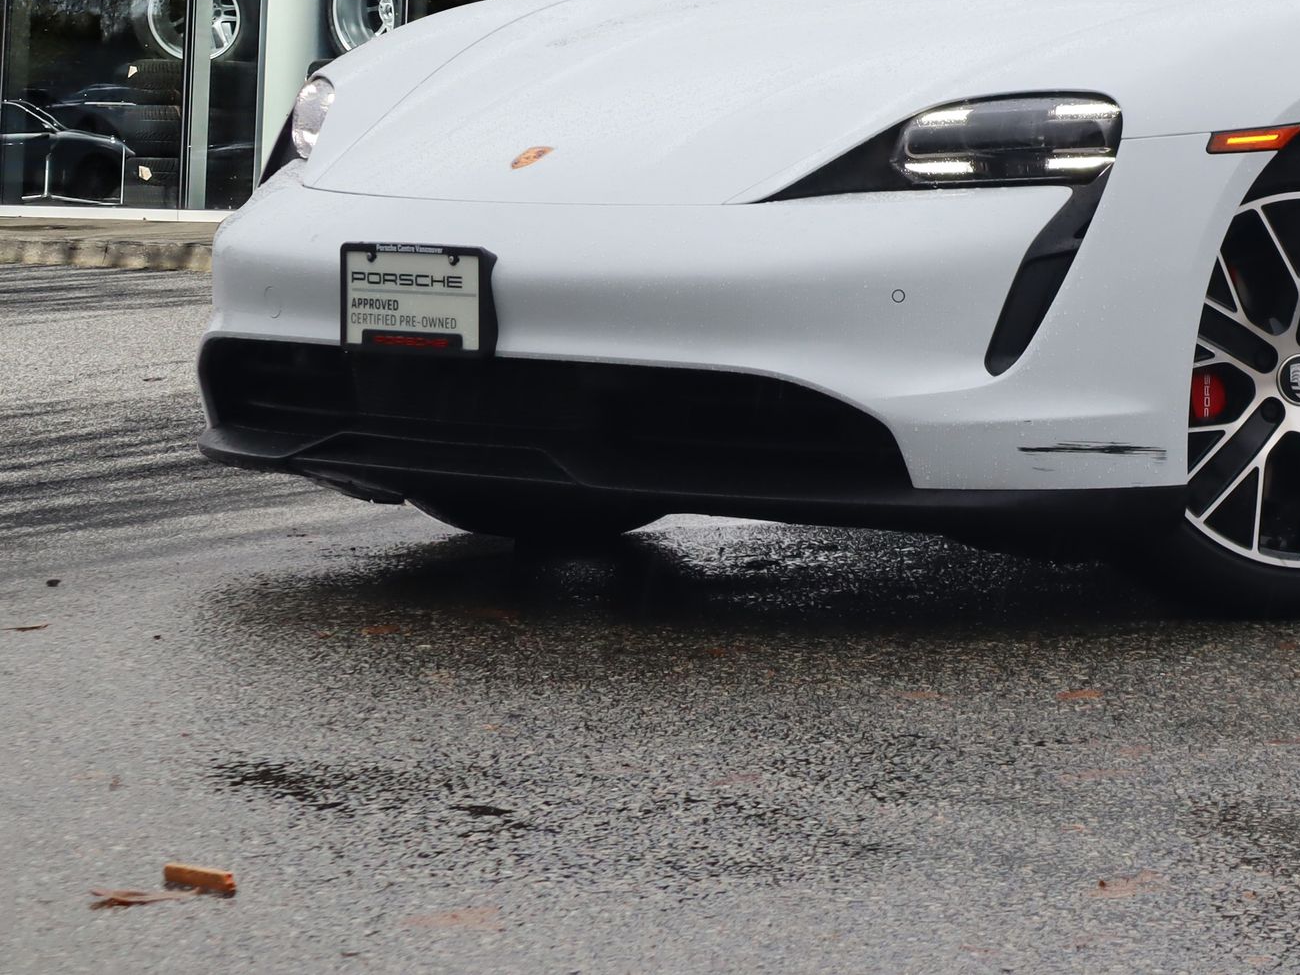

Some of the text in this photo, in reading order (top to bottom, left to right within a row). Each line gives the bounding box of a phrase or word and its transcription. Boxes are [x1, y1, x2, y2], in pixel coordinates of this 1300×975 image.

[351, 271, 463, 289] PORSCHE
[351, 297, 399, 311] APPROVED
[351, 312, 457, 329] CERTIFIED PRE-OWNED
